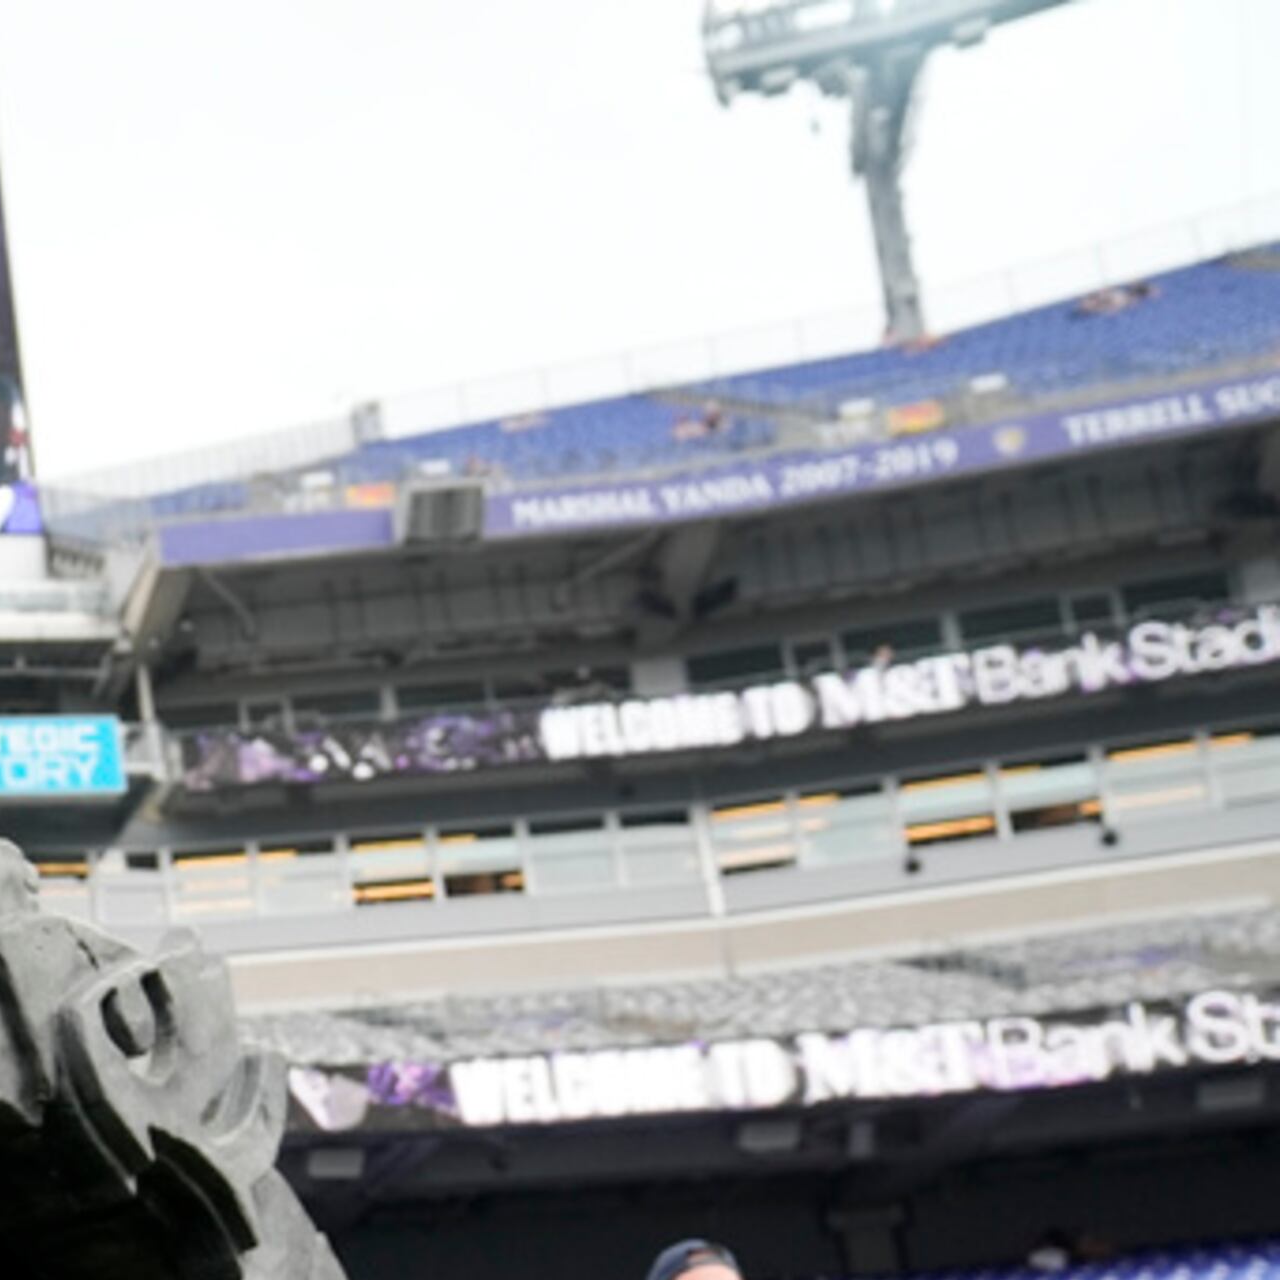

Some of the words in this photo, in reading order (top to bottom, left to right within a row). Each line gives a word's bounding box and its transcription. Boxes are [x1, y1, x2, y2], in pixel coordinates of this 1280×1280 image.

[1062, 393, 1210, 446] TERRELL
[511, 488, 652, 527] MARSHAL
[660, 472, 772, 516] YANDA
[781, 438, 958, 496] 2007-2019
[540, 691, 741, 759] WELCOME
[741, 682, 812, 739] TO
[816, 653, 970, 728] M&T
[974, 632, 1128, 703] Bank
[450, 1045, 706, 1125] WELCOME
[707, 1039, 798, 1109] TO
[801, 1017, 981, 1104] M&T
[983, 1002, 1186, 1090] Bank
[1187, 989, 1280, 1064] St
